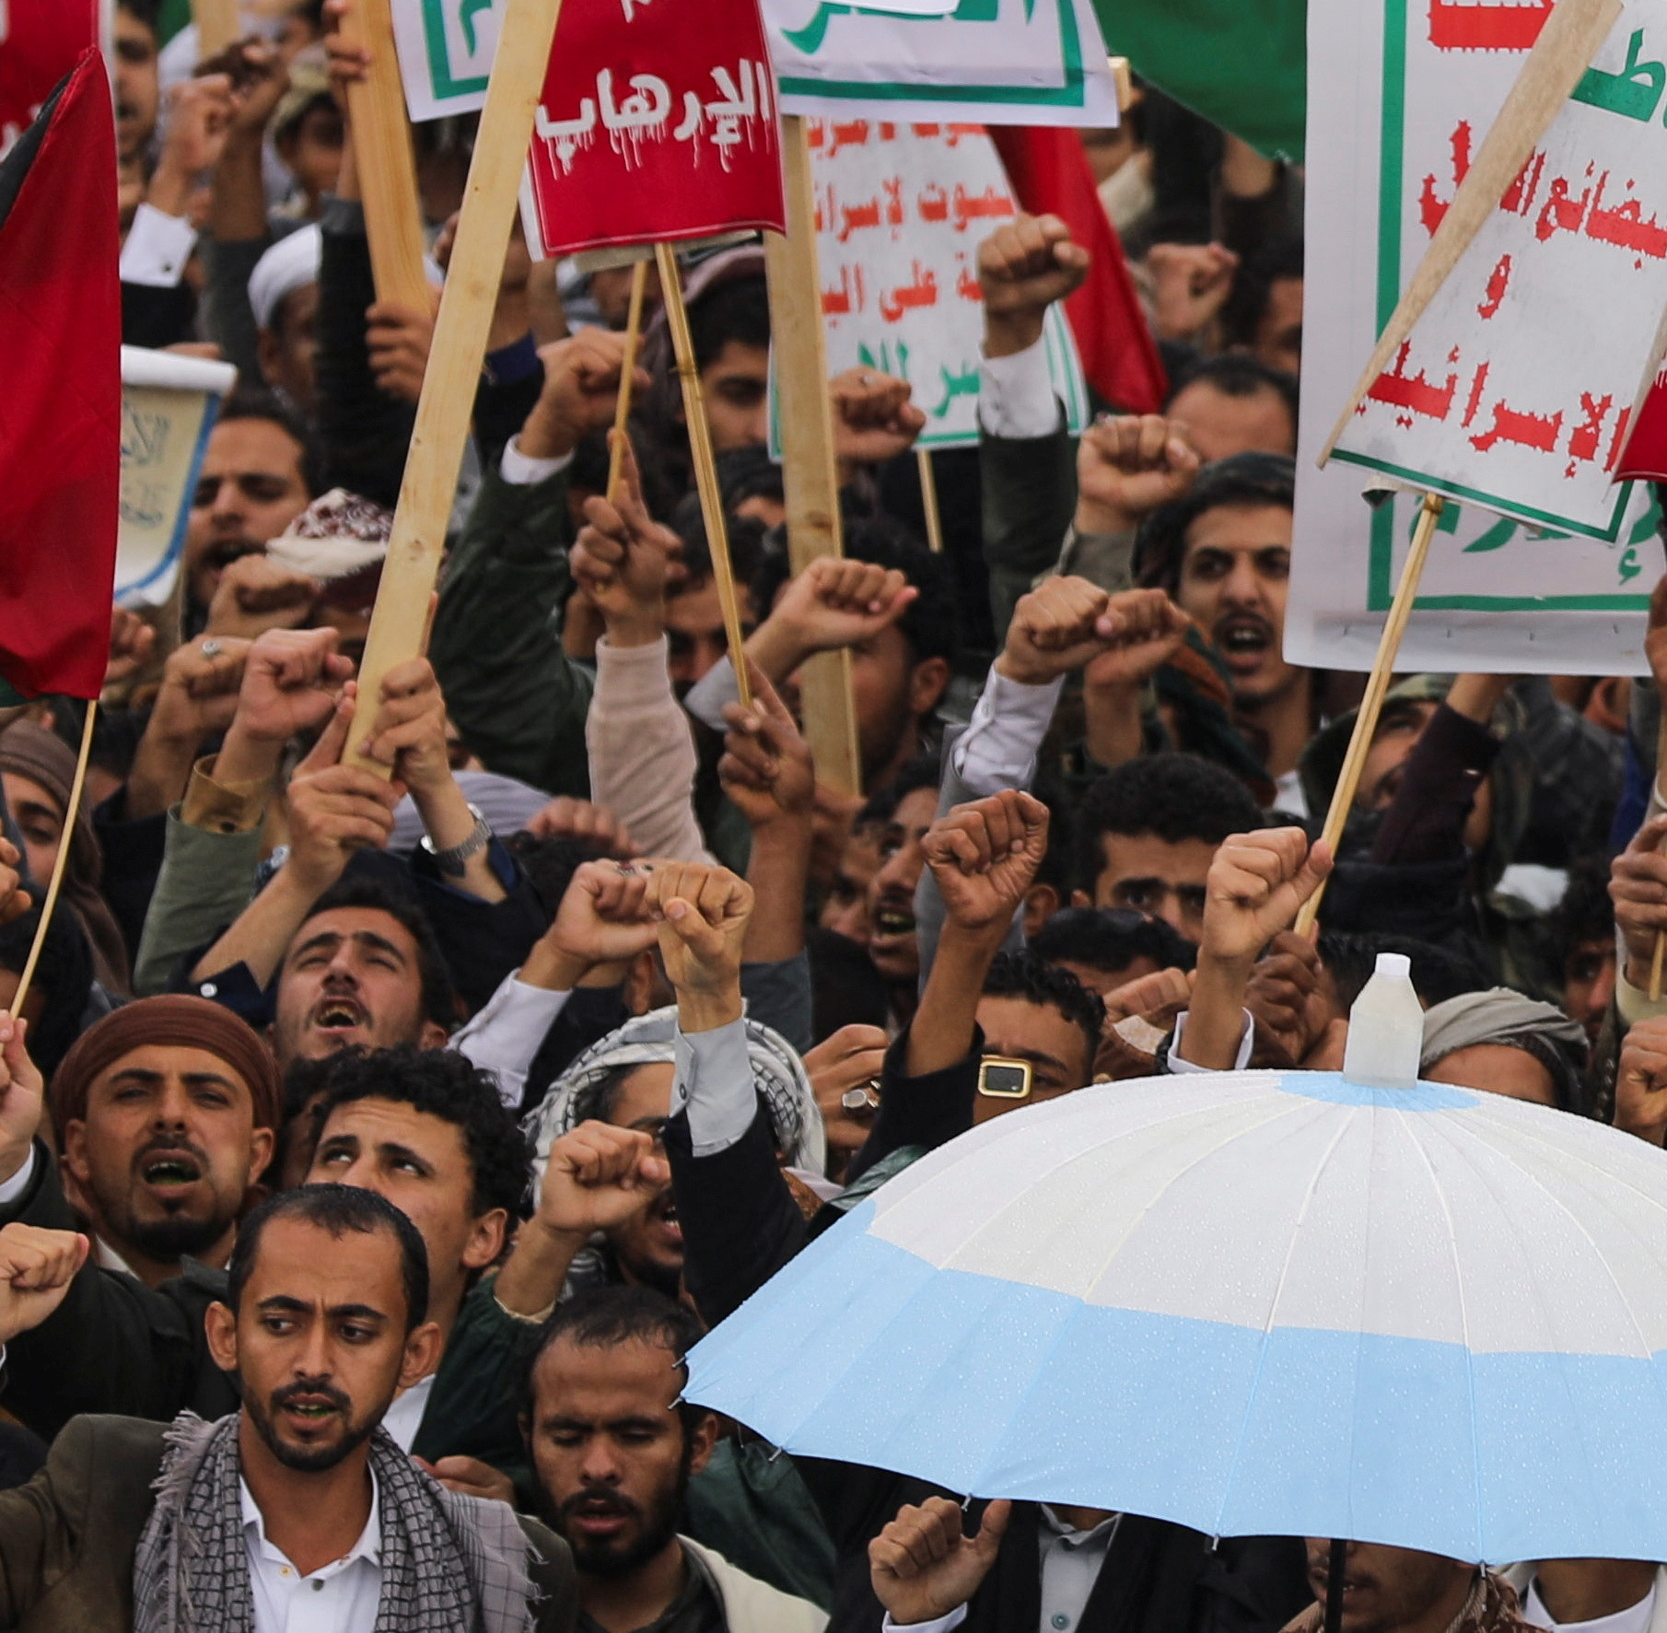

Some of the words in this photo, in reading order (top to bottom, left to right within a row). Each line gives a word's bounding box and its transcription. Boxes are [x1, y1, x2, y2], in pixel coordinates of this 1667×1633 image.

[533, 59, 773, 172] الإرهاب
[878, 258, 938, 323] على
[1478, 254, 1511, 319] و
